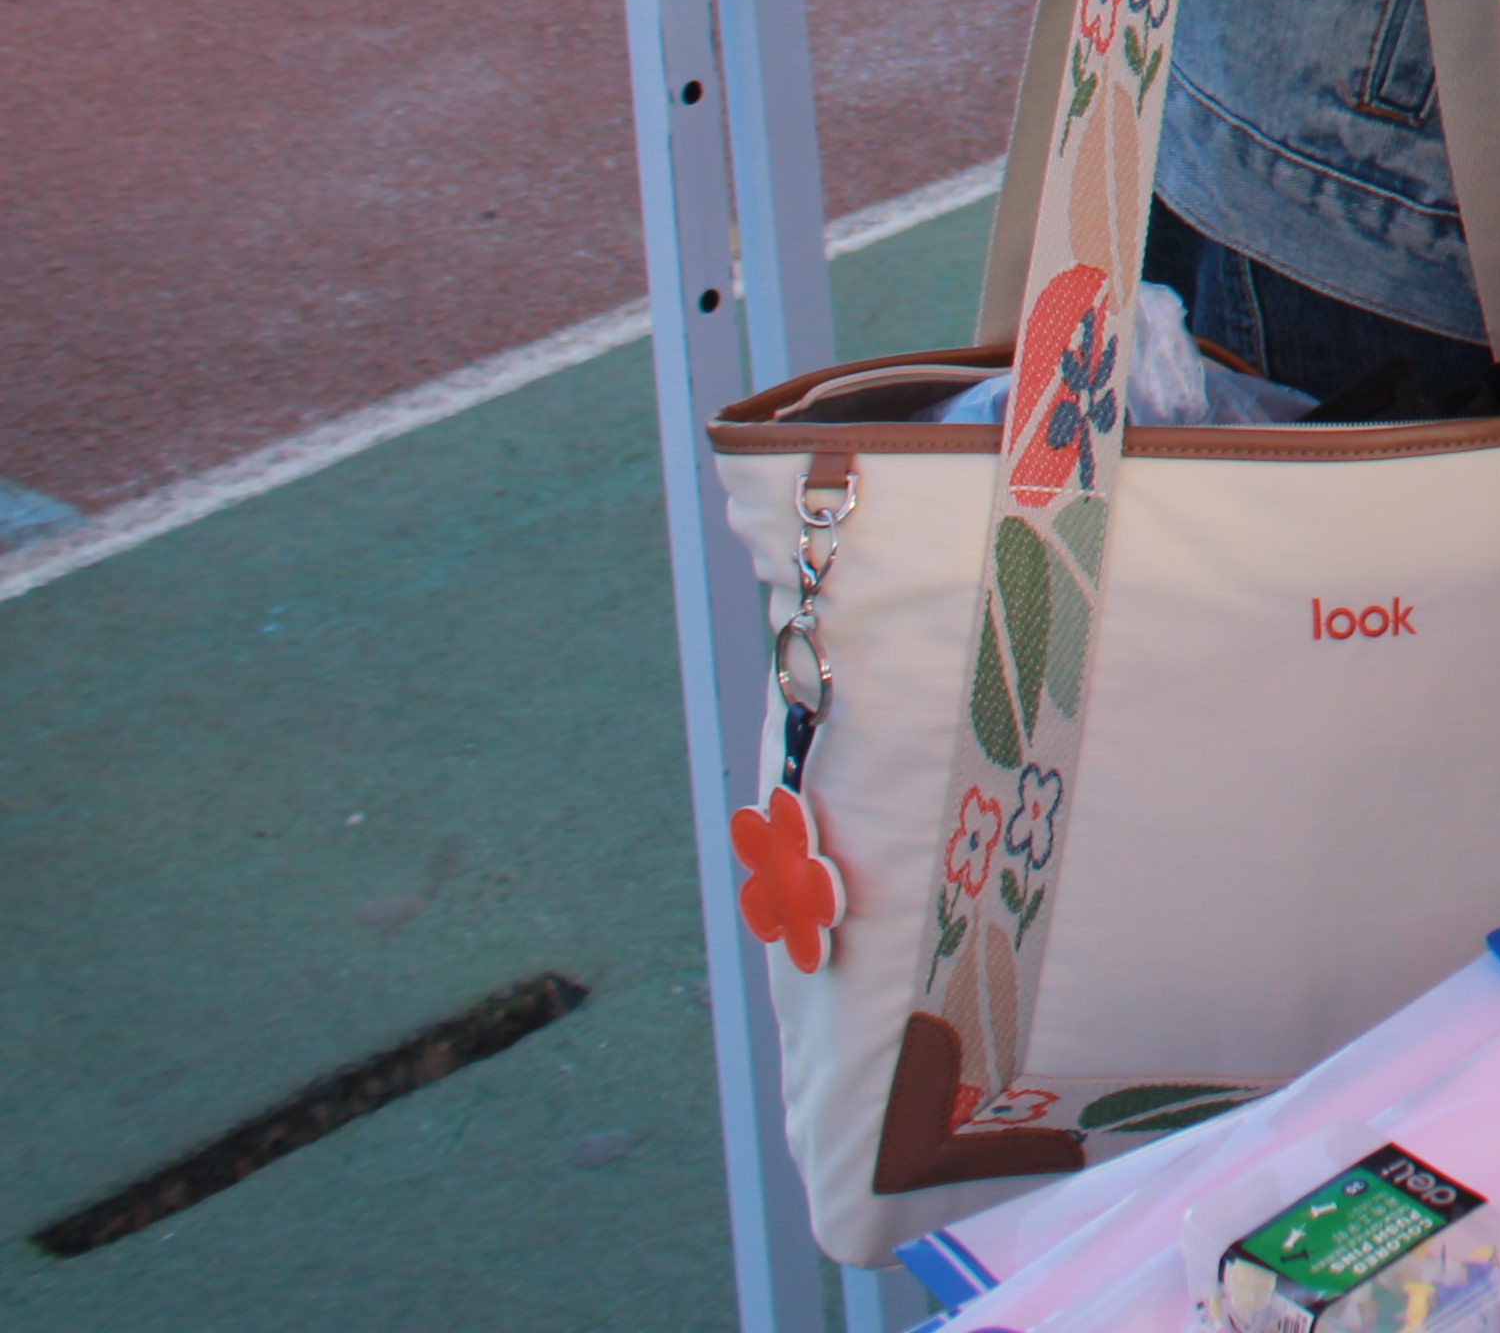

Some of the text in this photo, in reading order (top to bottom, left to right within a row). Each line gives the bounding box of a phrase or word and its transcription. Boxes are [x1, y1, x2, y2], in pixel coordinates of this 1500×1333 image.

[1311, 595, 1418, 641] look
[1380, 1158, 1458, 1207] deli
[1352, 1217, 1434, 1276] COLORED
